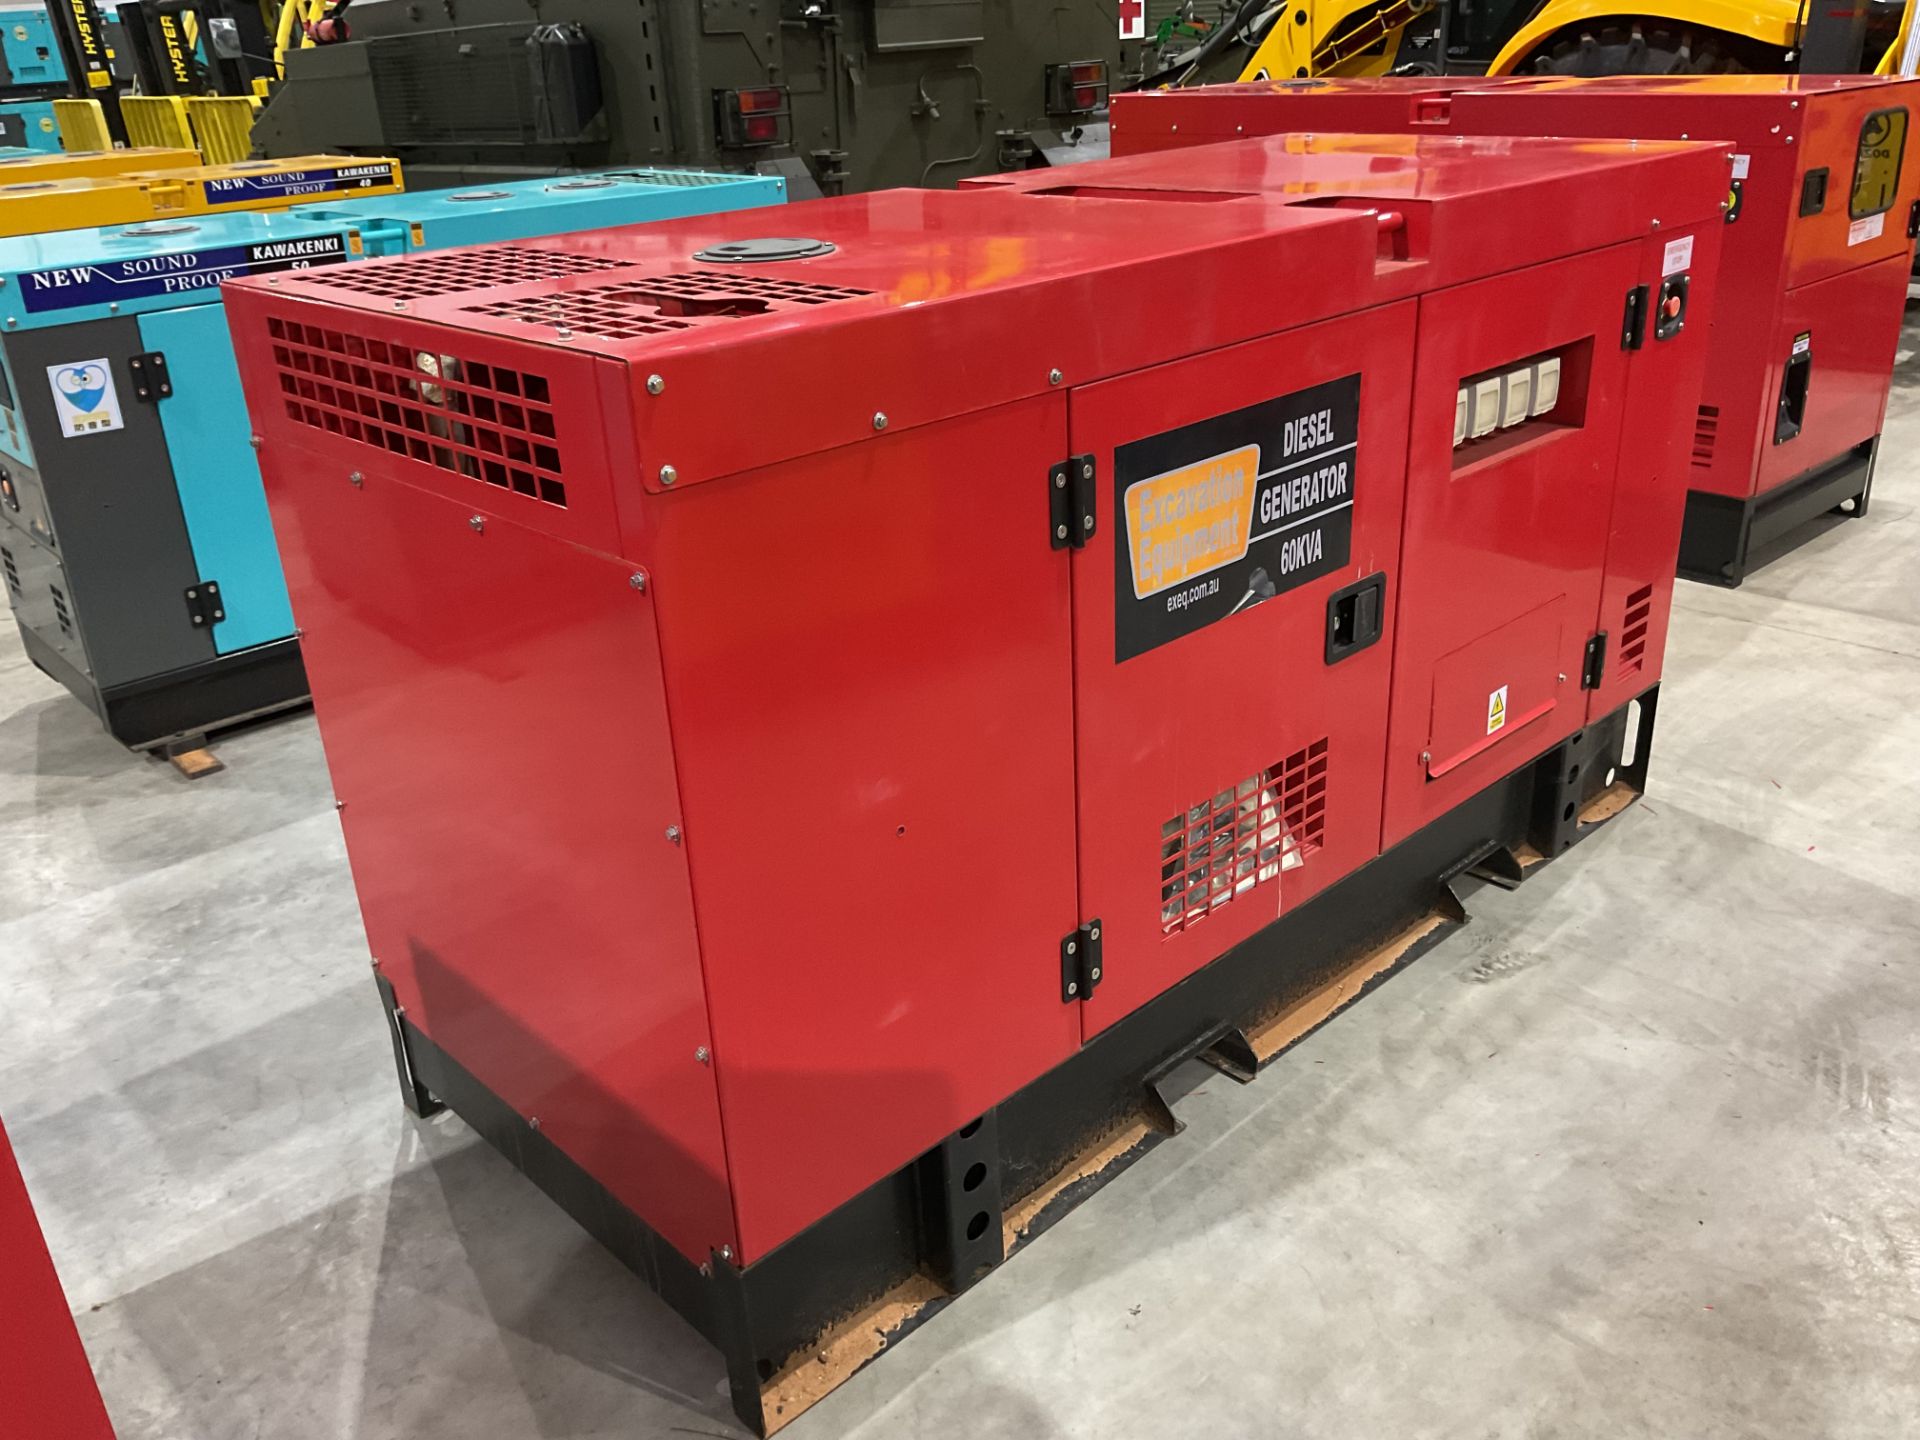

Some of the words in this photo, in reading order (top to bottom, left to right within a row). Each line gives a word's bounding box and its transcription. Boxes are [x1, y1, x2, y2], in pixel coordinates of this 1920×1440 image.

[71, 0, 98, 54] HYSTE
[160, 15, 189, 82] HYSTER
[211, 178, 245, 191] NEW
[261, 172, 305, 185] SOUND
[285, 183, 326, 196] PROOF
[337, 165, 390, 178] KAWAKENKI
[359, 178, 372, 187] 40
[252, 238, 338, 260] KAWAKENKI
[32, 266, 92, 290] NEW
[122, 253, 198, 276] SOUND
[164, 270, 234, 293] PROOF
[1283, 408, 1335, 458] DIESEL
[1140, 464, 1245, 533] Excavation
[1260, 461, 1348, 525] GENERATOR
[1140, 507, 1240, 585] Equipment
[1280, 528, 1323, 575] 60KVA
[1167, 577, 1220, 613] exeq.com.au
